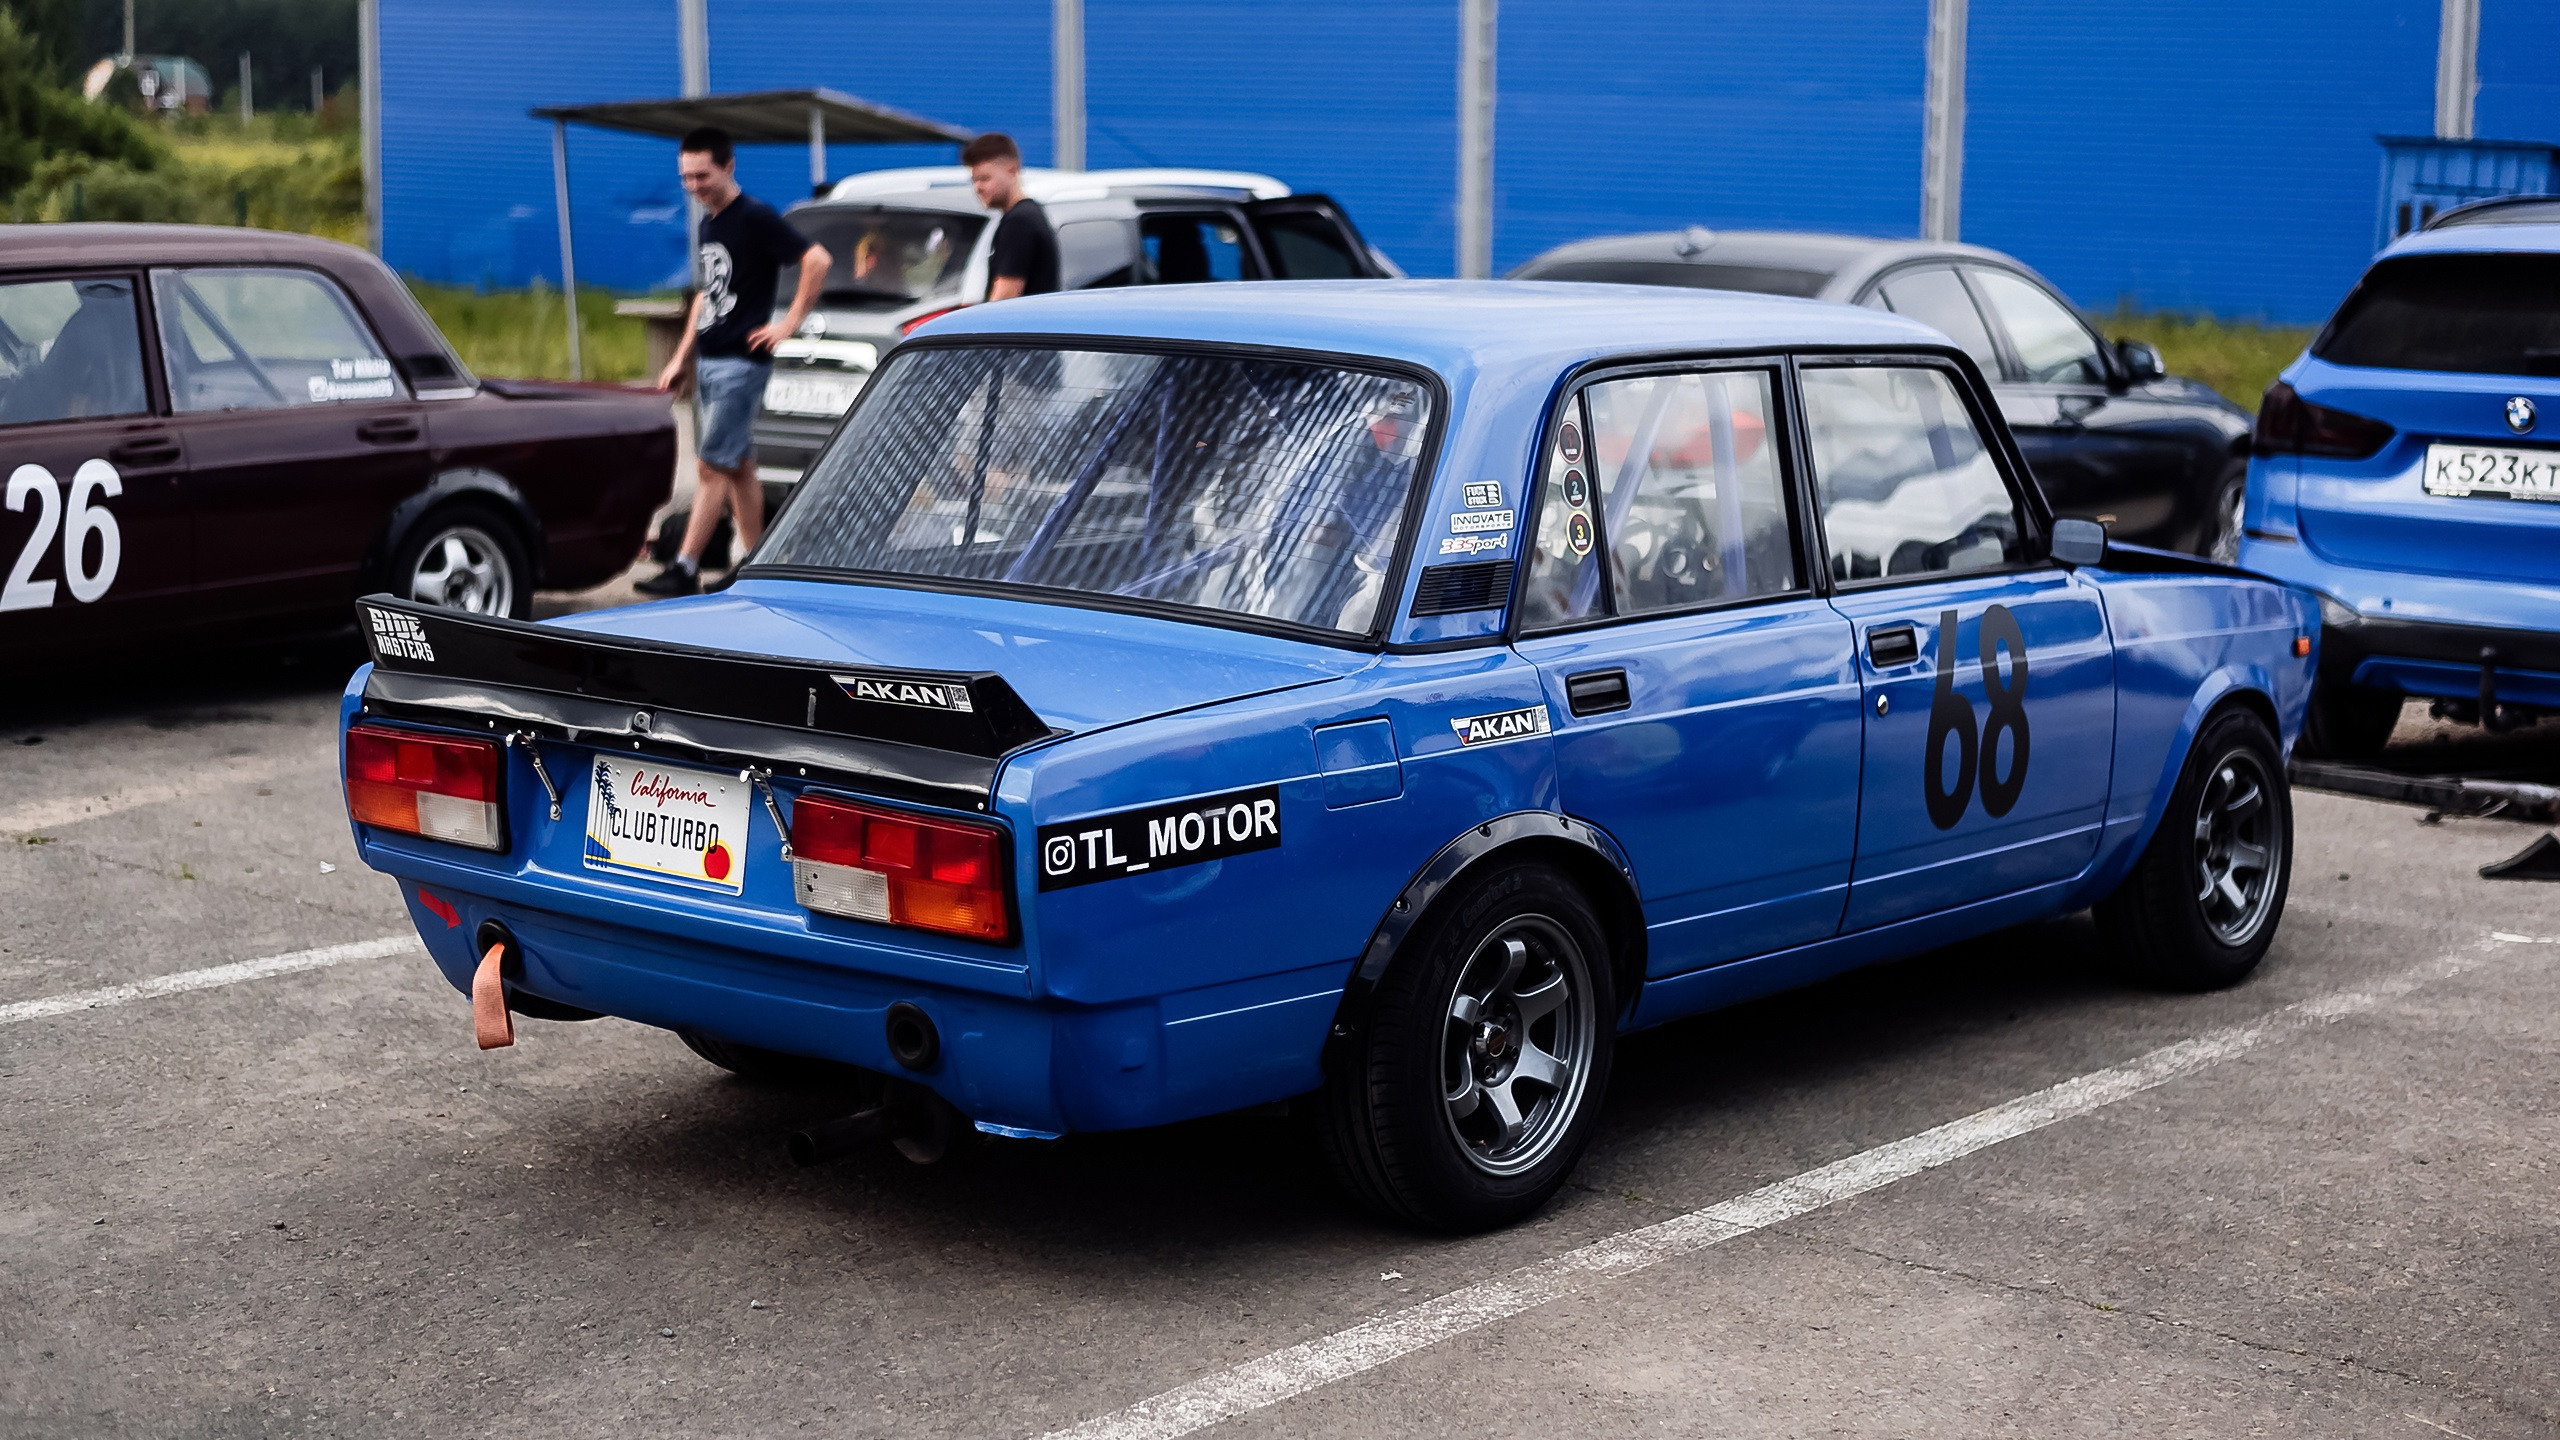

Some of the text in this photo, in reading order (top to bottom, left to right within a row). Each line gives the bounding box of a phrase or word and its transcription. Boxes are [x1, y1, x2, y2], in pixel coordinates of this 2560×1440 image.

[1572, 481, 1579, 495] 2
[0, 458, 123, 612] 26
[1453, 512, 1511, 525] INNOVATE
[1576, 524, 1585, 540] 3
[367, 607, 426, 642] SIDE
[857, 681, 947, 706] AKAN
[1468, 712, 1534, 741] AKAN
[1924, 604, 2030, 831] 68
[631, 770, 717, 808] California
[611, 807, 720, 854] CLUBTURBO
[1079, 799, 1279, 872] TL_MOTOR
